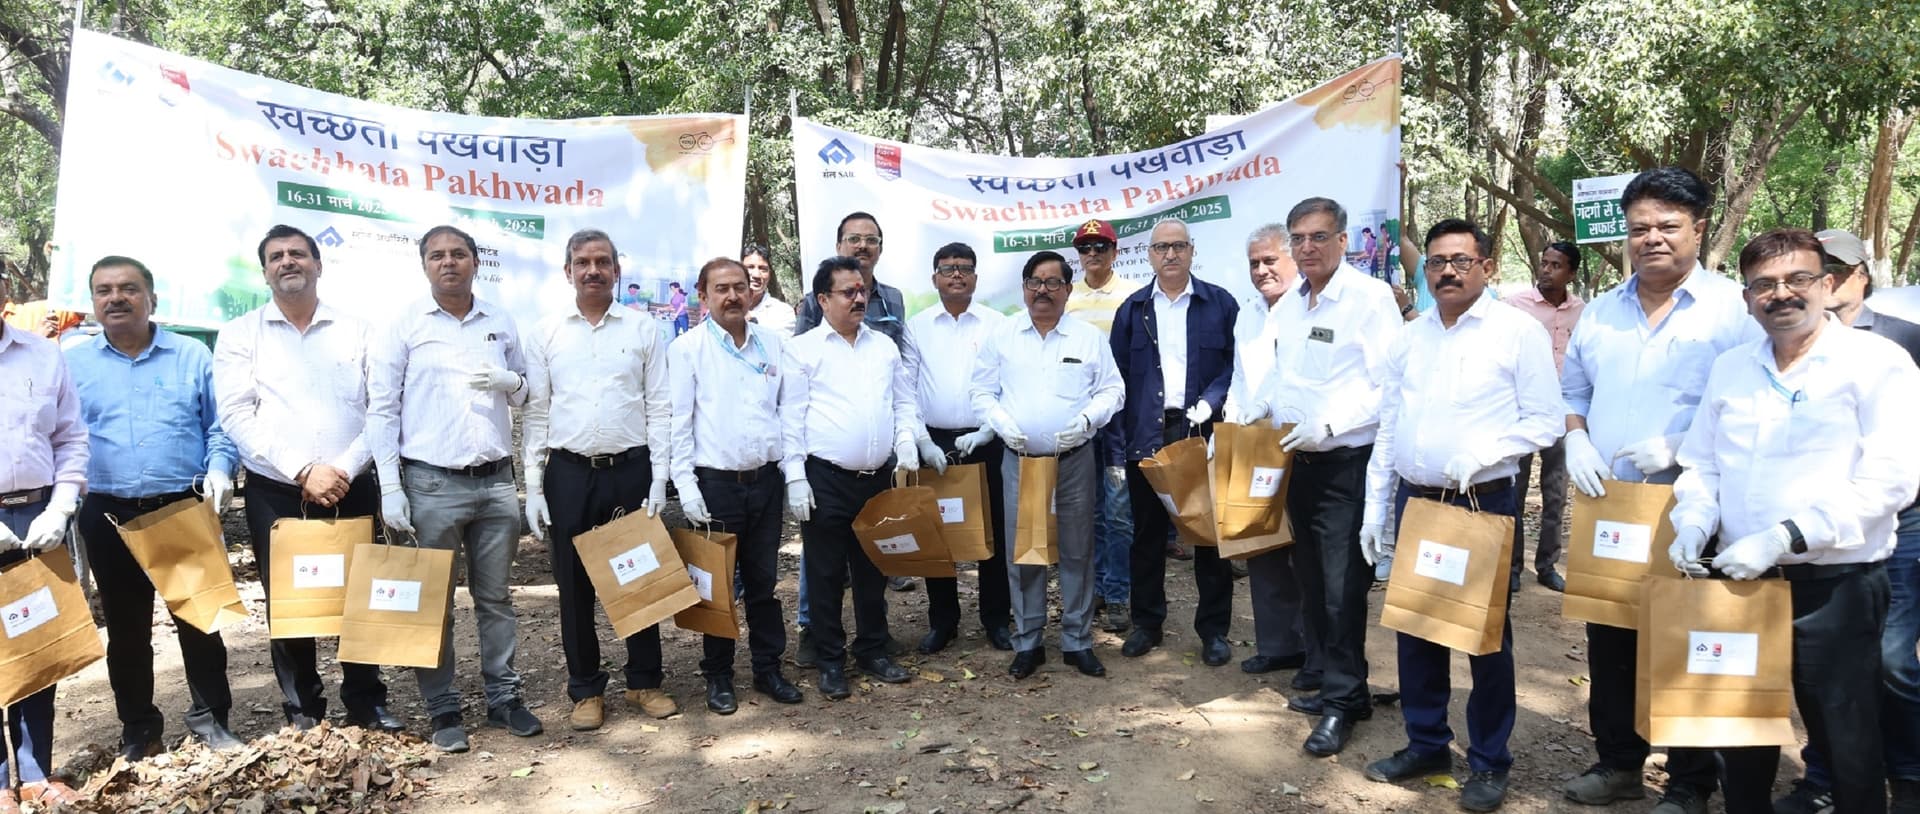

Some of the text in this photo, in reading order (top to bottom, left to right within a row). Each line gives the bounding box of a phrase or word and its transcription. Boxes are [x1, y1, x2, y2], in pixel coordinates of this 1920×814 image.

[256, 100, 566, 172] स्वच्छता पखवाड़ा
[1111, 130, 1247, 180] पखवाड़ा
[216, 131, 604, 207] Swachhata Pakhwada
[931, 153, 1280, 222] Swachhata Pakhwada
[287, 190, 387, 214] 16-31 मार्च 202
[1191, 202, 1223, 217] 2025
[1576, 202, 1601, 220] गंदगी
[1603, 201, 1614, 217] से
[503, 219, 536, 233] 2025
[1588, 217, 1617, 235] सफाई
[1002, 234, 1037, 248] 16-31
[1041, 230, 1066, 246] मार्च
